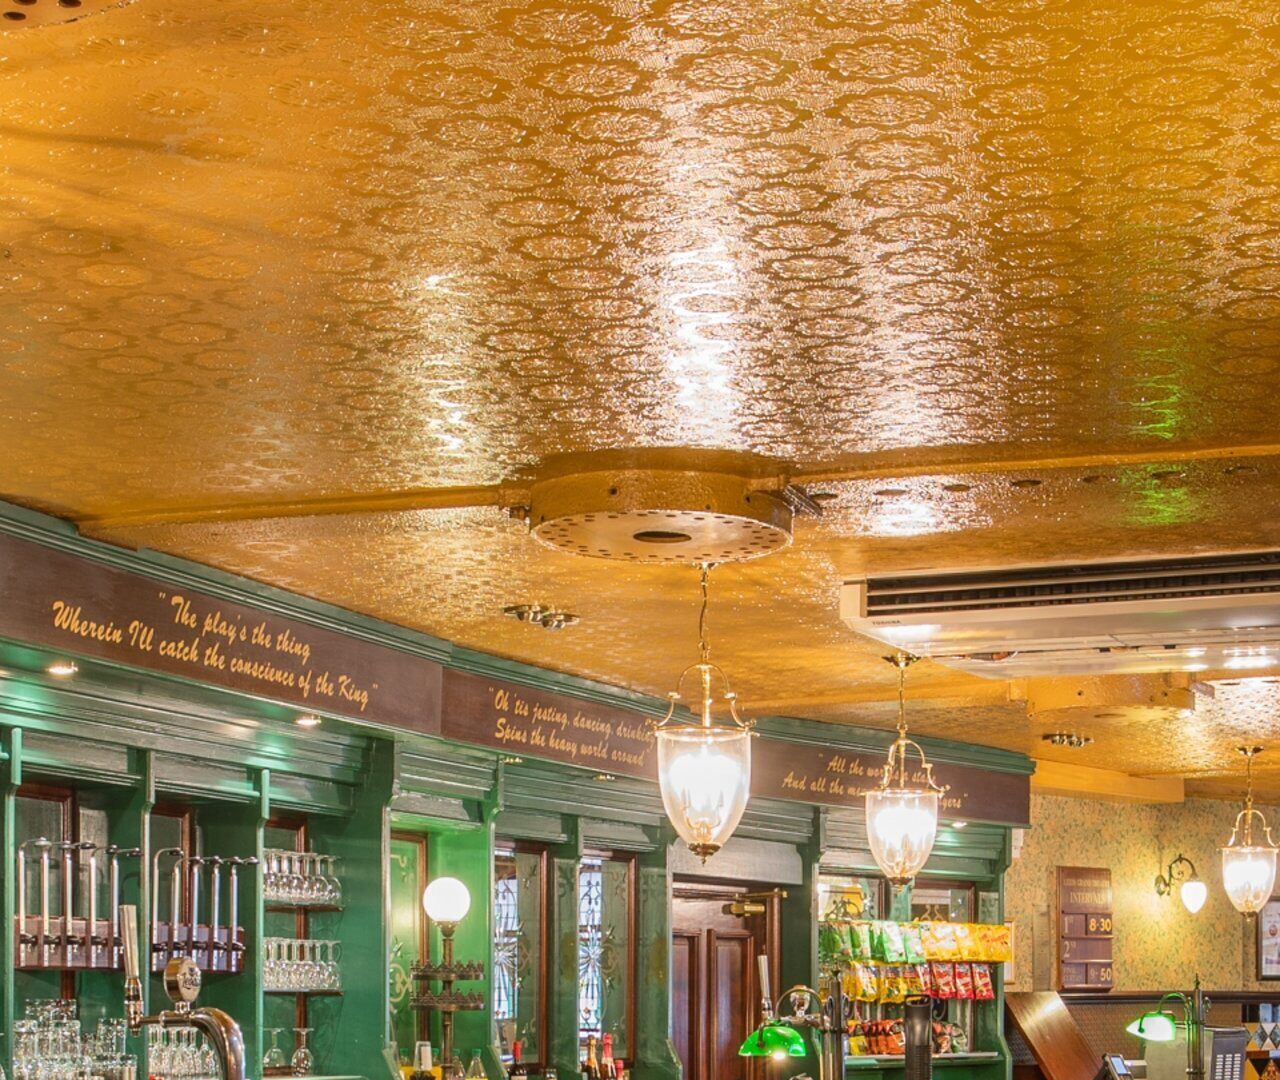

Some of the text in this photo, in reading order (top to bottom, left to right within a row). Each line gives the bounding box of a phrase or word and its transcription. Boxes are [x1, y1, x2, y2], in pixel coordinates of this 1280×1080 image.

[52, 600, 123, 643] Wherein
[128, 619, 154, 652] I'll
[159, 637, 200, 663] catch
[203, 641, 226, 670] the
[229, 653, 295, 687] conscience
[298, 669, 312, 698] of
[315, 670, 335, 697] the
[202, 610, 248, 646] play's
[251, 621, 272, 648] the
[276, 628, 311, 665] thing
[495, 717, 528, 744] Spins
[530, 726, 546, 747] the
[548, 729, 578, 758] heavy
[580, 739, 608, 759] world
[781, 771, 807, 791] And
[810, 775, 827, 793] all
[829, 777, 844, 795] the
[826, 755, 846, 774] All
[848, 757, 864, 777] the
